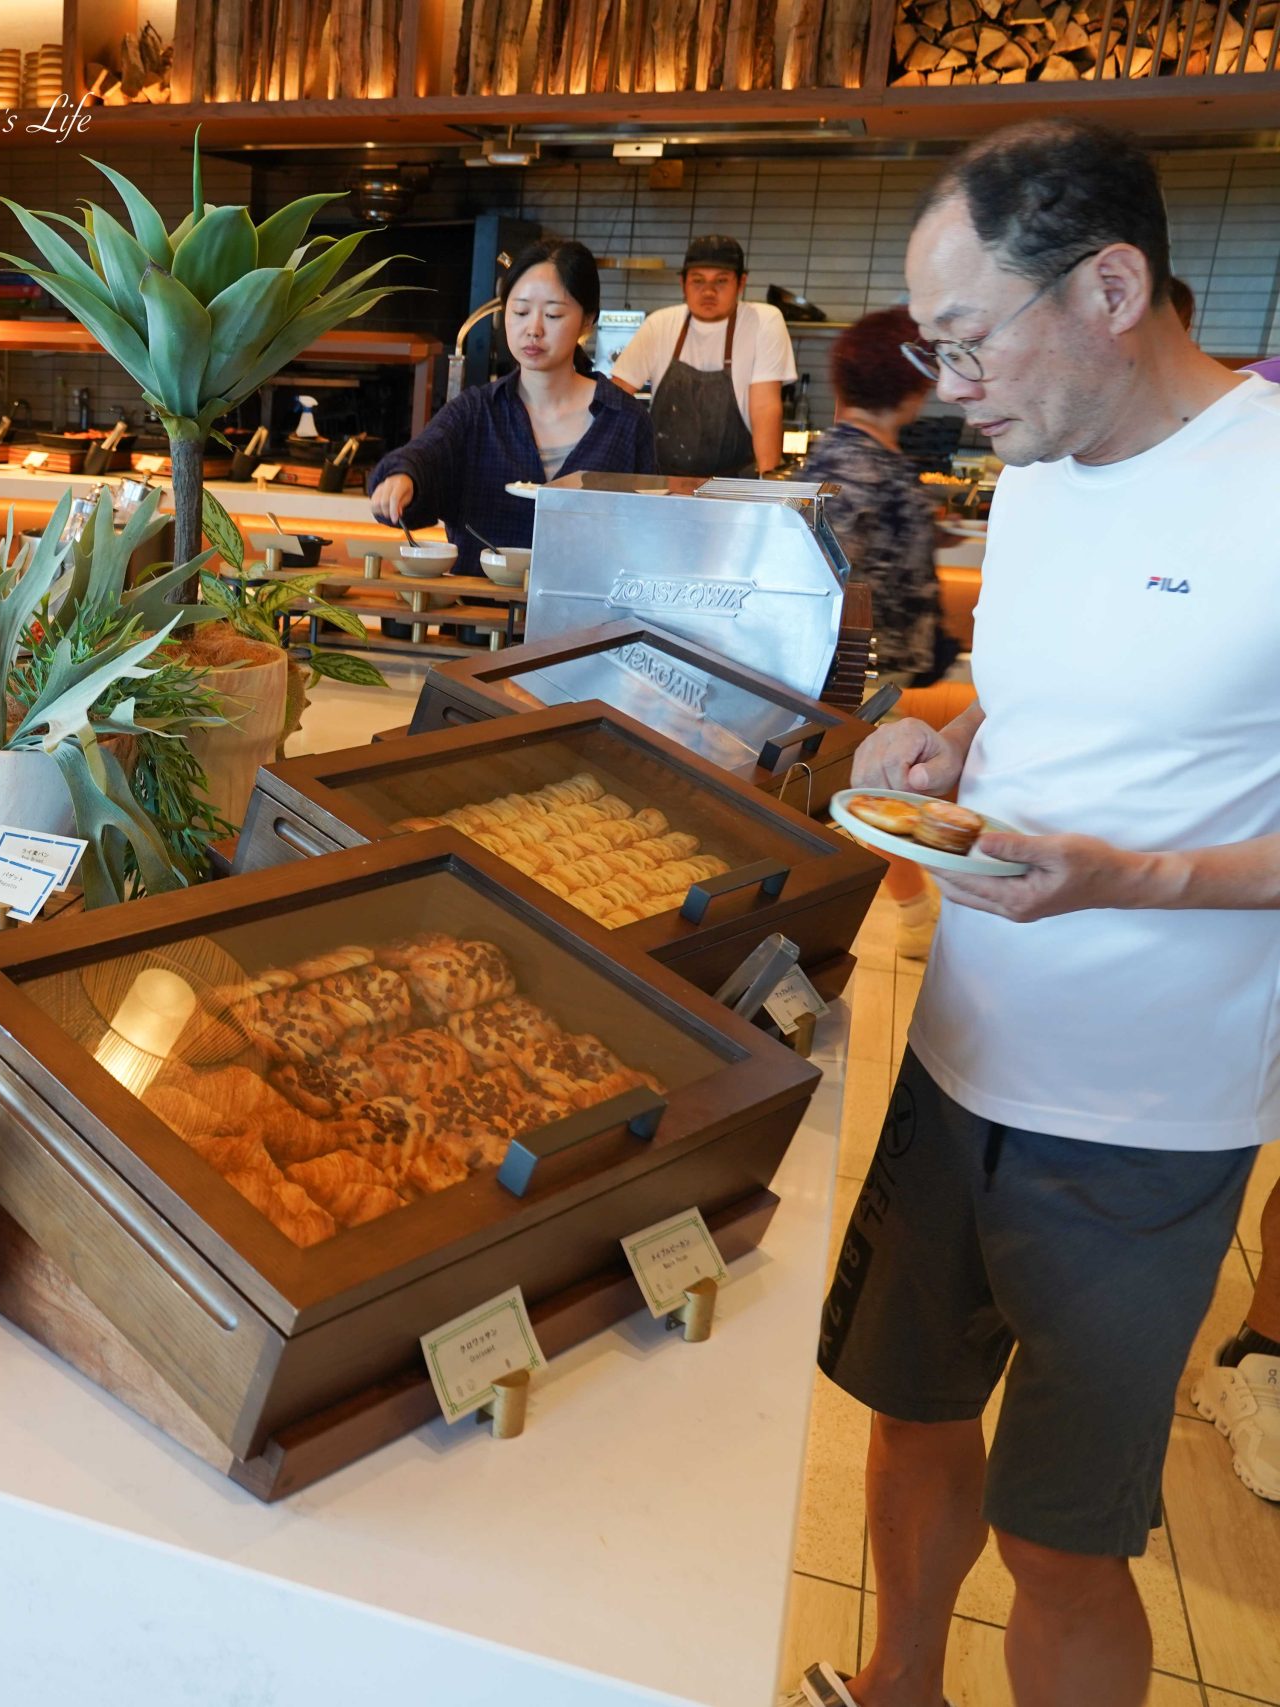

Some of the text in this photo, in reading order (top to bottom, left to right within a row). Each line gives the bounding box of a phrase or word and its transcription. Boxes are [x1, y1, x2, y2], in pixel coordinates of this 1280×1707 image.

[1146, 576, 1191, 594] FILA
[459, 1328, 499, 1354] クロワッサン
